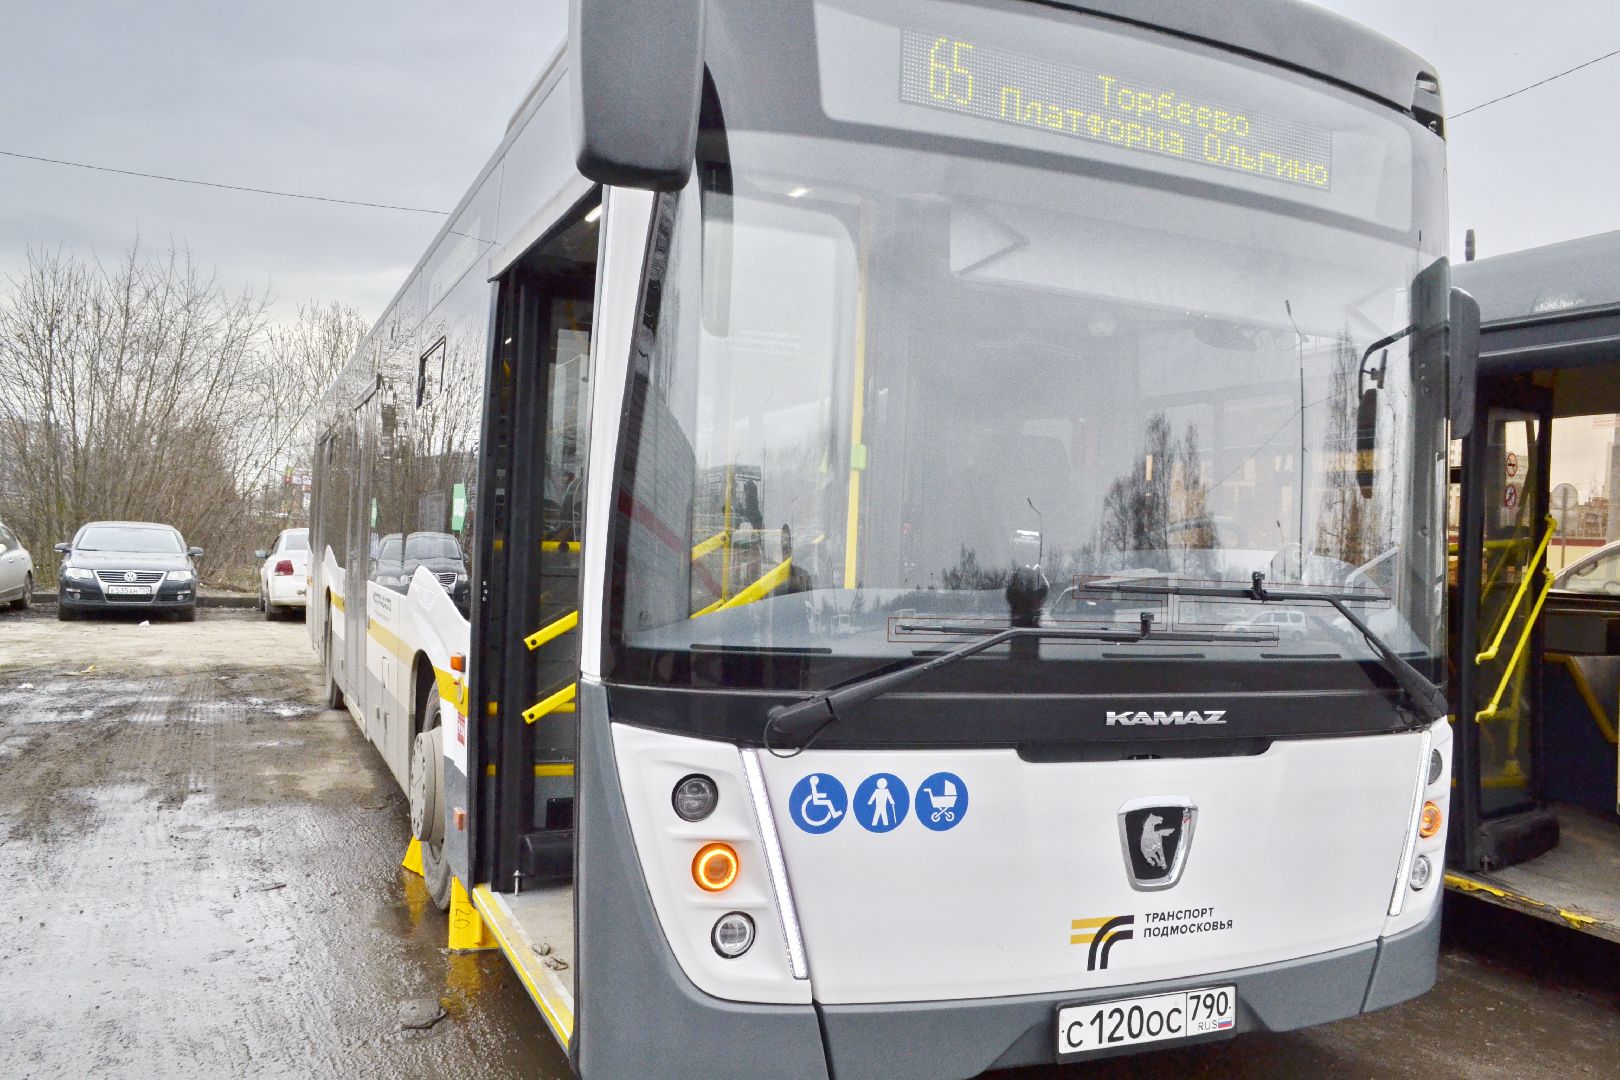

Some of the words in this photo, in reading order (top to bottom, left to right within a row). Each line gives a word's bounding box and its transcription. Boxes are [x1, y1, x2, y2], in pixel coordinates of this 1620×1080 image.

[928, 37, 975, 106] 65
[1098, 74, 1250, 138] Торбеево
[1000, 86, 1185, 155] Платформа
[1203, 132, 1329, 187] Ольгино
[1105, 709, 1227, 727] KAMAZ
[1144, 907, 1214, 924] ТРАНСПОРТ
[1143, 919, 1234, 939] ПОДМОСКОВЬЯ
[1189, 991, 1229, 1021] 790
[1197, 1018, 1219, 1032] RUS
